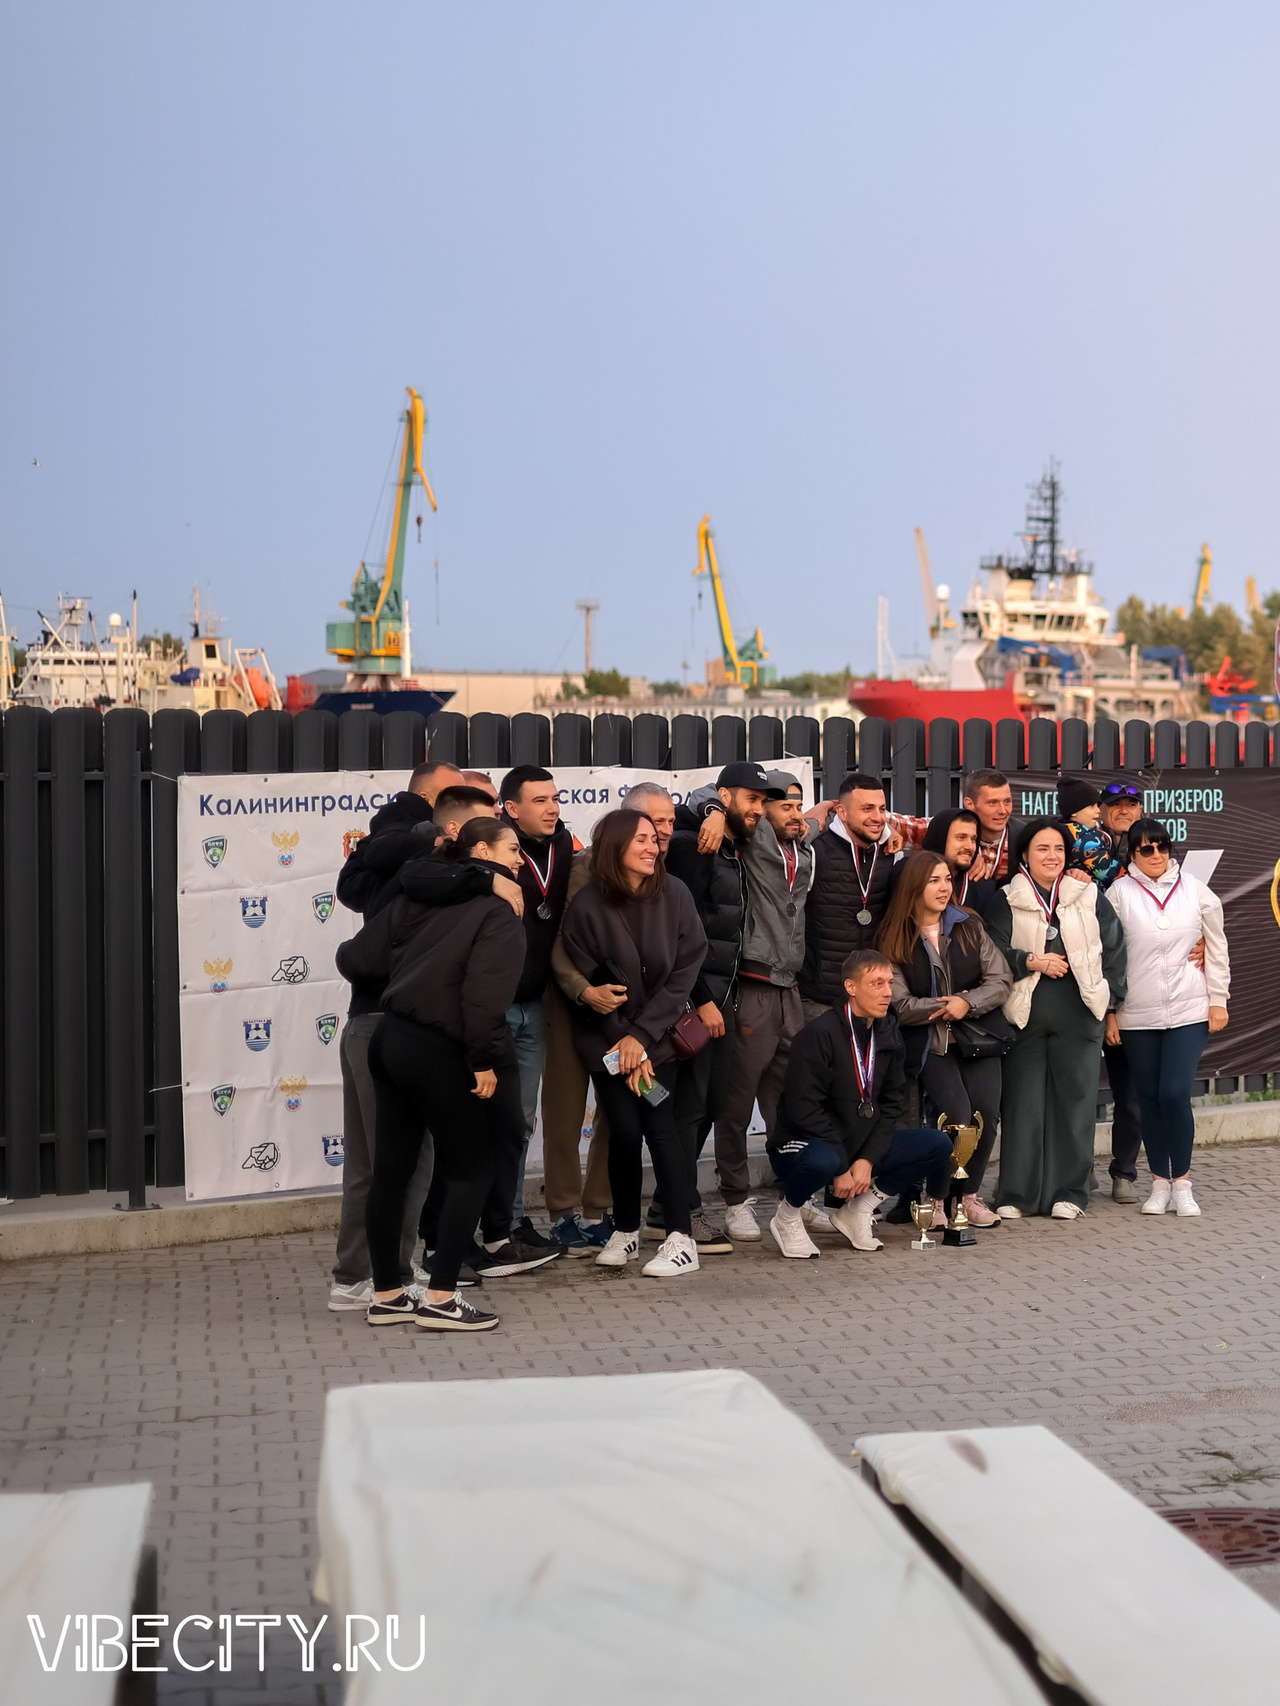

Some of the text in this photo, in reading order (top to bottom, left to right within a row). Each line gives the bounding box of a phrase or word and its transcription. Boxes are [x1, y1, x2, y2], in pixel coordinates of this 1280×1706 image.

[199, 793, 397, 817] Калининградск
[558, 789, 609, 804] ская
[1022, 788, 1224, 816] НАГР ПРИЗЕРОВ
